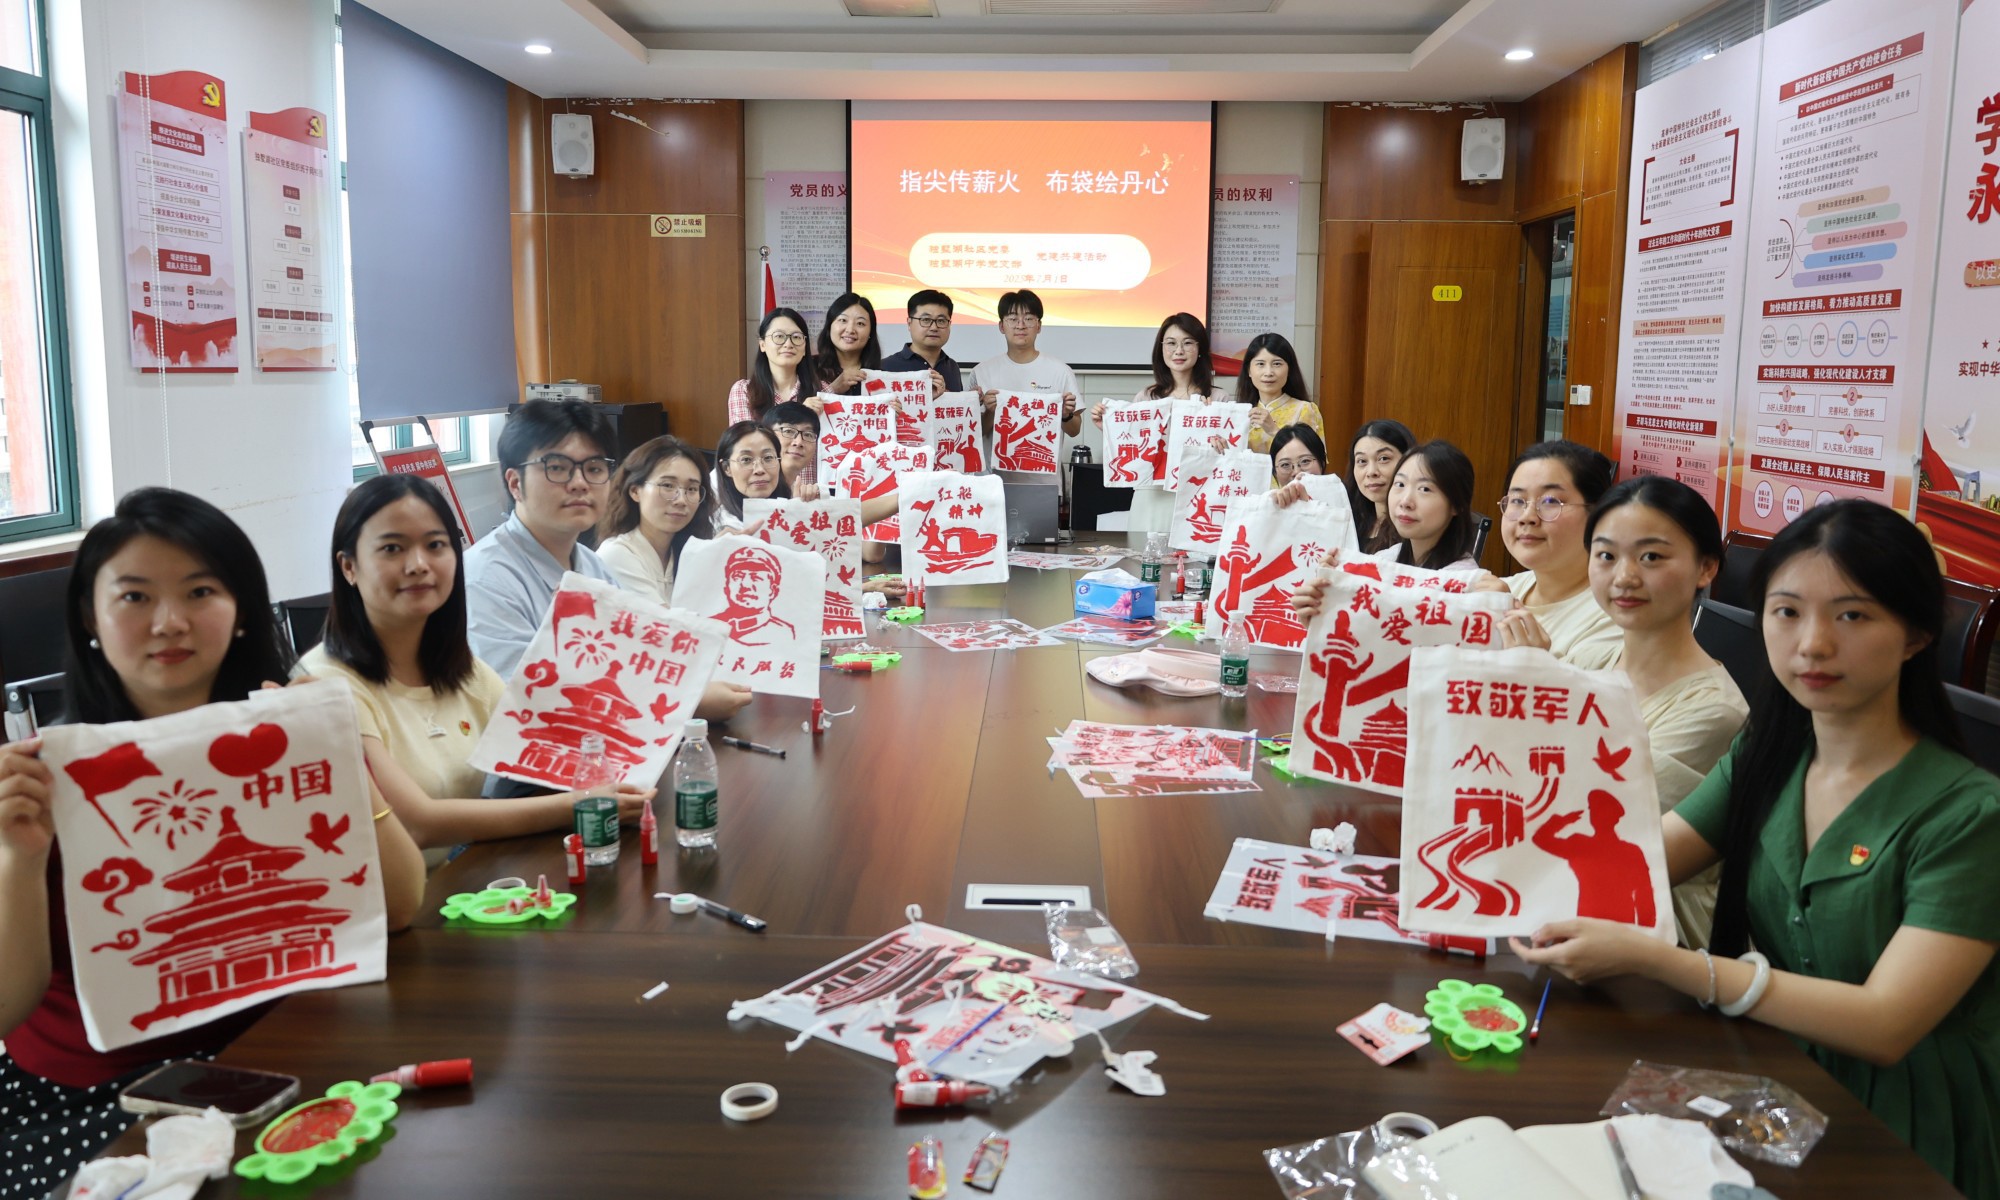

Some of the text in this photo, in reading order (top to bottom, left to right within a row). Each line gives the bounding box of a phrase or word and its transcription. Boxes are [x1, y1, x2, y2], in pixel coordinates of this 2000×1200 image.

[1795, 44, 1902, 93] 新时代新征程中国共产党的使命任务
[900, 169, 1169, 196] 指尖传薪火 布袋绘丹心
[673, 218, 702, 226] 禁止吸烟
[1036, 252, 1108, 262] 党建共建活动
[1438, 289, 1457, 298] 411
[1769, 293, 1892, 313] 加快构建新发展格局，着力推动高质量发展
[1763, 367, 1887, 380] 实施科教兴国战略，强化现代化建设人才支撑
[1958, 361, 2000, 377] 实现中华
[890, 380, 926, 392] 我爱你
[904, 393, 926, 406] 中国
[1006, 394, 1058, 418] 我爱祖国
[850, 402, 889, 415] 我爱你
[934, 406, 973, 419] 致敬军人
[1114, 408, 1164, 423] 致敬军人
[863, 416, 888, 430] 中国
[1182, 415, 1235, 430] 致敬军人
[861, 447, 927, 471] 我爱祖国
[1212, 467, 1242, 481] 红船
[1761, 458, 1870, 483] 发展全过程人民民主，保障人民当家作主
[938, 486, 973, 502] 红船
[1218, 486, 1249, 498] 精神
[948, 503, 984, 520] 精神
[767, 508, 856, 545] 我爱祖国
[1351, 582, 1492, 645] 我爱祖国
[610, 610, 700, 656] 我爱你
[628, 651, 687, 686] 中国
[718, 654, 796, 679] 民服务
[1447, 680, 1609, 728] 致敬军人
[243, 759, 331, 809] 中国
